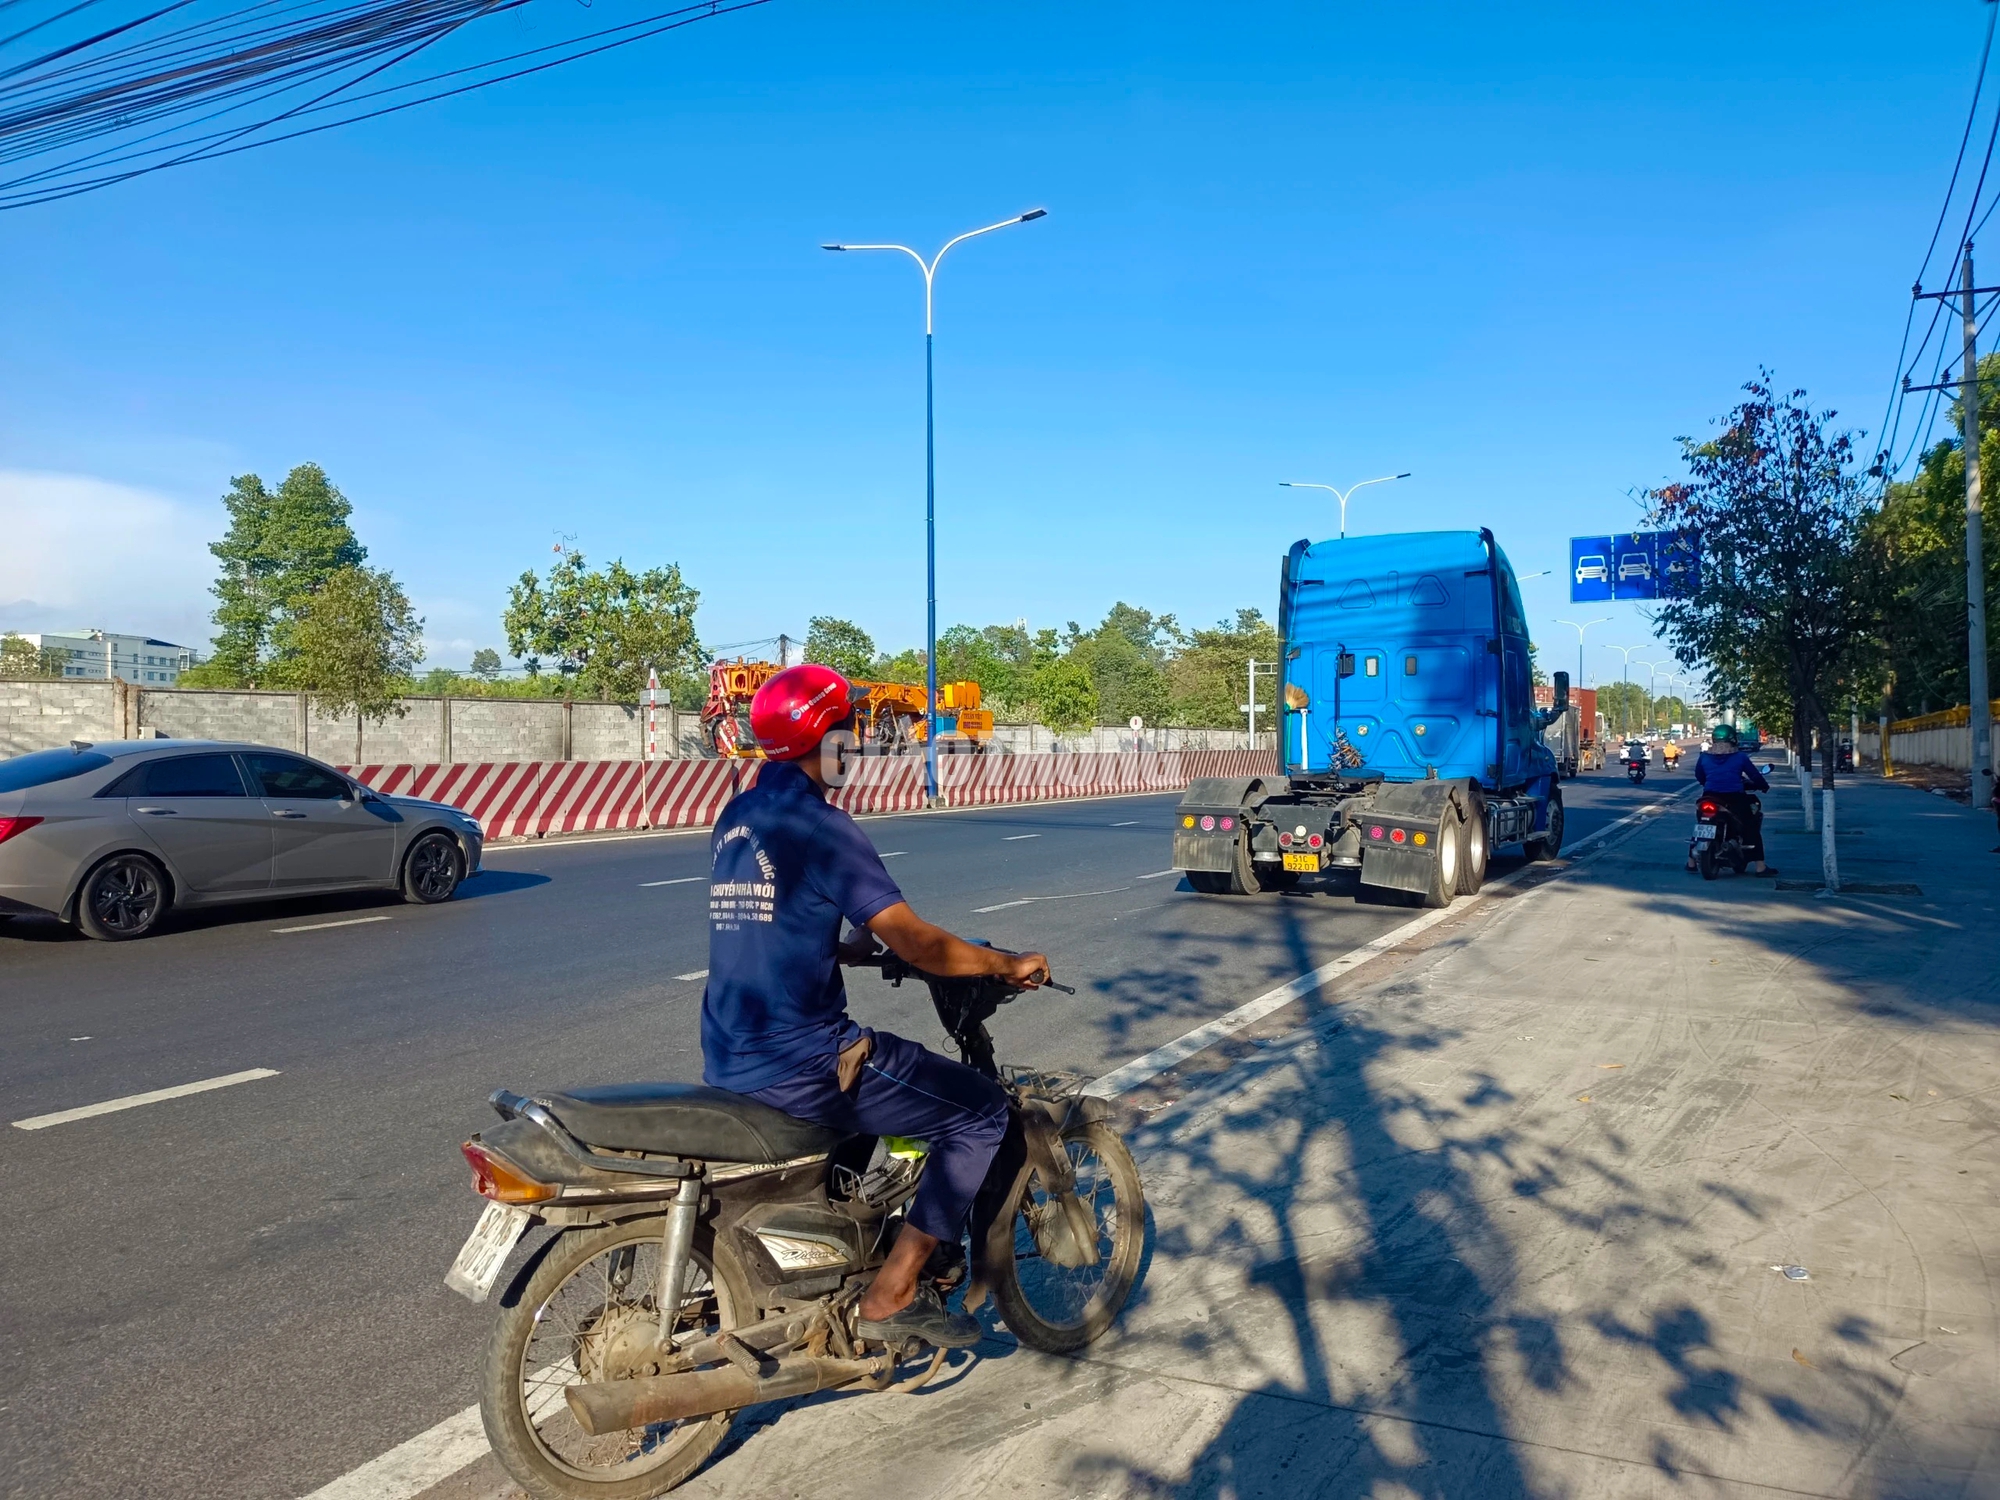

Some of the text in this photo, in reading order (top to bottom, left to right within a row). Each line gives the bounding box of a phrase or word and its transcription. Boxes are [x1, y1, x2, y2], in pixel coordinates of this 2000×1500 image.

[1293, 854, 1308, 862] 51C
[1287, 862, 1315, 871] 922.07
[750, 1159, 792, 1173] HONDA
